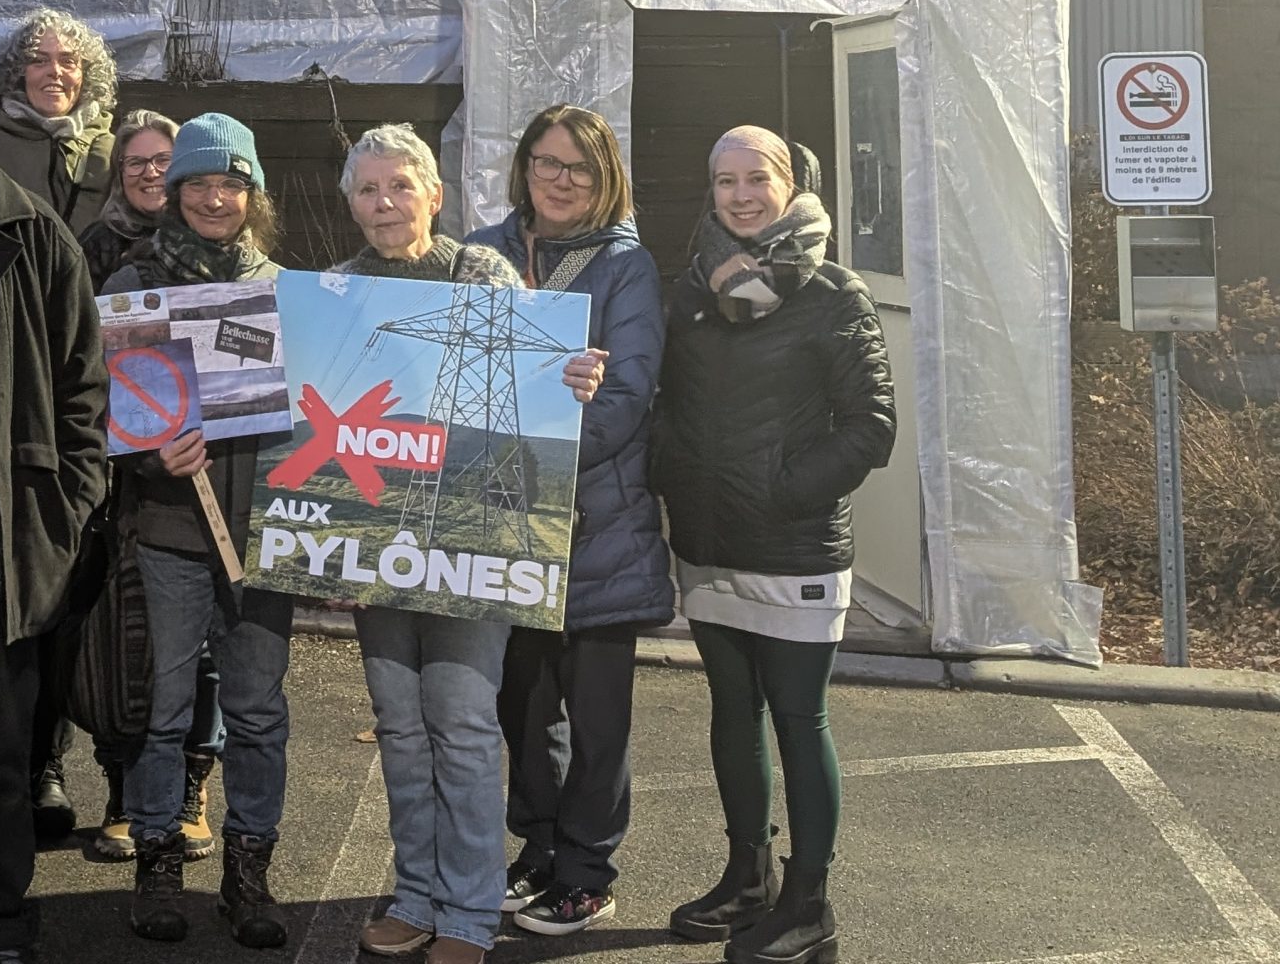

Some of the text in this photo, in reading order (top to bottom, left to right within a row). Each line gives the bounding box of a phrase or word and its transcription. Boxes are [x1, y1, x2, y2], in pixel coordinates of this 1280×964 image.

[1122, 145, 1188, 154] Interdiction de
[1115, 155, 1197, 165] fumer et vapoter à
[1115, 166, 1142, 174] moins
[1145, 166, 1156, 174] de
[1158, 166, 1164, 174] 9
[1132, 176, 1181, 184] de l'édifice
[222, 324, 270, 345] Bellechasse
[336, 424, 441, 464] NON!
[264, 498, 332, 525] AUX
[258, 528, 560, 609] PYLÔNES!
